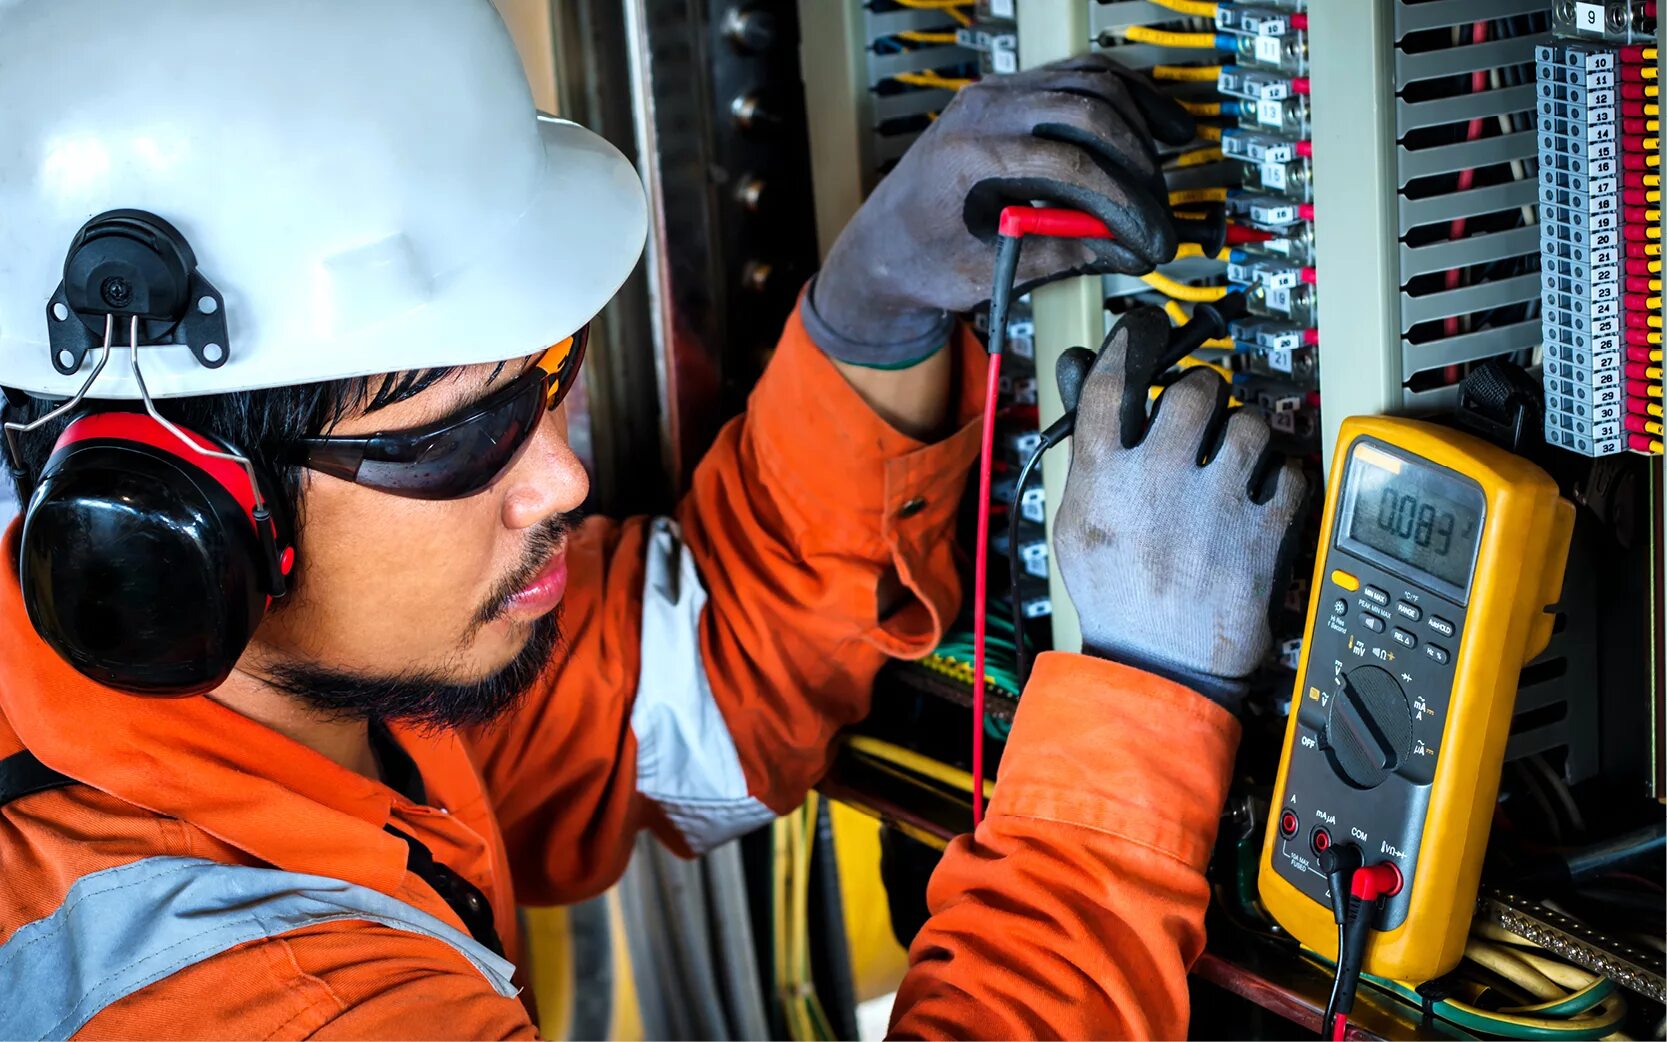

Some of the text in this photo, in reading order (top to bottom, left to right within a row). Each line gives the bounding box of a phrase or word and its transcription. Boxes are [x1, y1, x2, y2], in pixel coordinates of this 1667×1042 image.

[1588, 11, 1596, 24] 9
[1268, 25, 1278, 33] 10
[1595, 59, 1607, 68] 10
[1596, 76, 1607, 85] 11
[1269, 89, 1280, 97] 12
[1596, 94, 1607, 104] 12
[1597, 112, 1608, 121] 13
[1597, 129, 1609, 139] 14
[1274, 152, 1285, 160] 14
[1599, 147, 1610, 157] 15
[1598, 162, 1609, 172] 16
[1598, 183, 1609, 192] 17
[1598, 200, 1610, 209] 18
[1598, 218, 1610, 227] 19
[1597, 235, 1609, 245] 20
[1598, 253, 1610, 262] 21
[1598, 270, 1611, 280] 22
[1598, 288, 1611, 297] 23
[1597, 304, 1610, 313] 24
[1599, 322, 1612, 331] 25
[1280, 339, 1291, 348] 20
[1600, 339, 1612, 349] 26
[1275, 351, 1288, 366] 21
[1600, 358, 1613, 367] 27
[1600, 375, 1613, 384] 28
[1601, 392, 1614, 401] 29
[1601, 408, 1613, 418] 30
[1601, 426, 1613, 435] 31
[1602, 443, 1615, 452] 32
[1358, 599, 1392, 619] PEAK MIN MAX
[1398, 604, 1416, 618] RANGE
[1394, 632, 1404, 642] REL
[1413, 700, 1426, 713] mA
[1416, 712, 1423, 721] A
[1301, 736, 1316, 749] OFF
[1290, 794, 1296, 804] A
[1351, 827, 1368, 842] COM
[1290, 860, 1307, 872] FUSED
[1299, 857, 1309, 867] MAX
